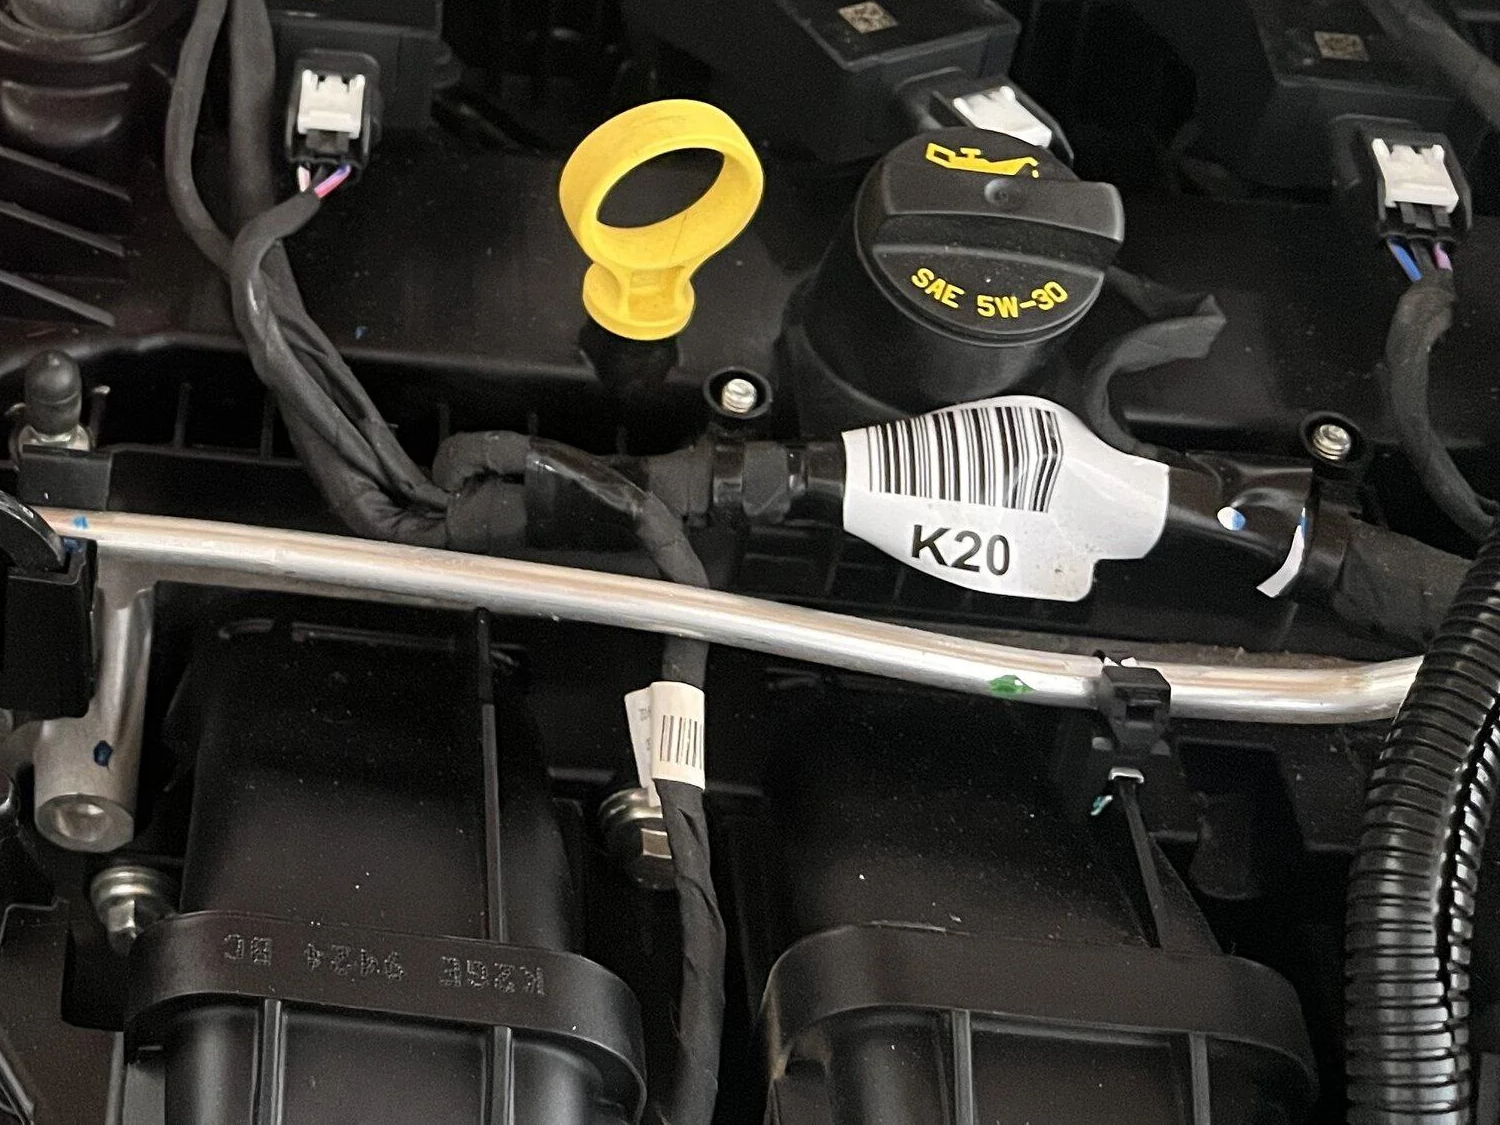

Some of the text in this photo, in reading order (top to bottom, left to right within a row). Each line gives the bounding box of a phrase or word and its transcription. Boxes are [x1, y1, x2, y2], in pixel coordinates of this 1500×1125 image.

[911, 267, 1068, 318] SAE 5W-30
[911, 524, 1011, 577] K20
